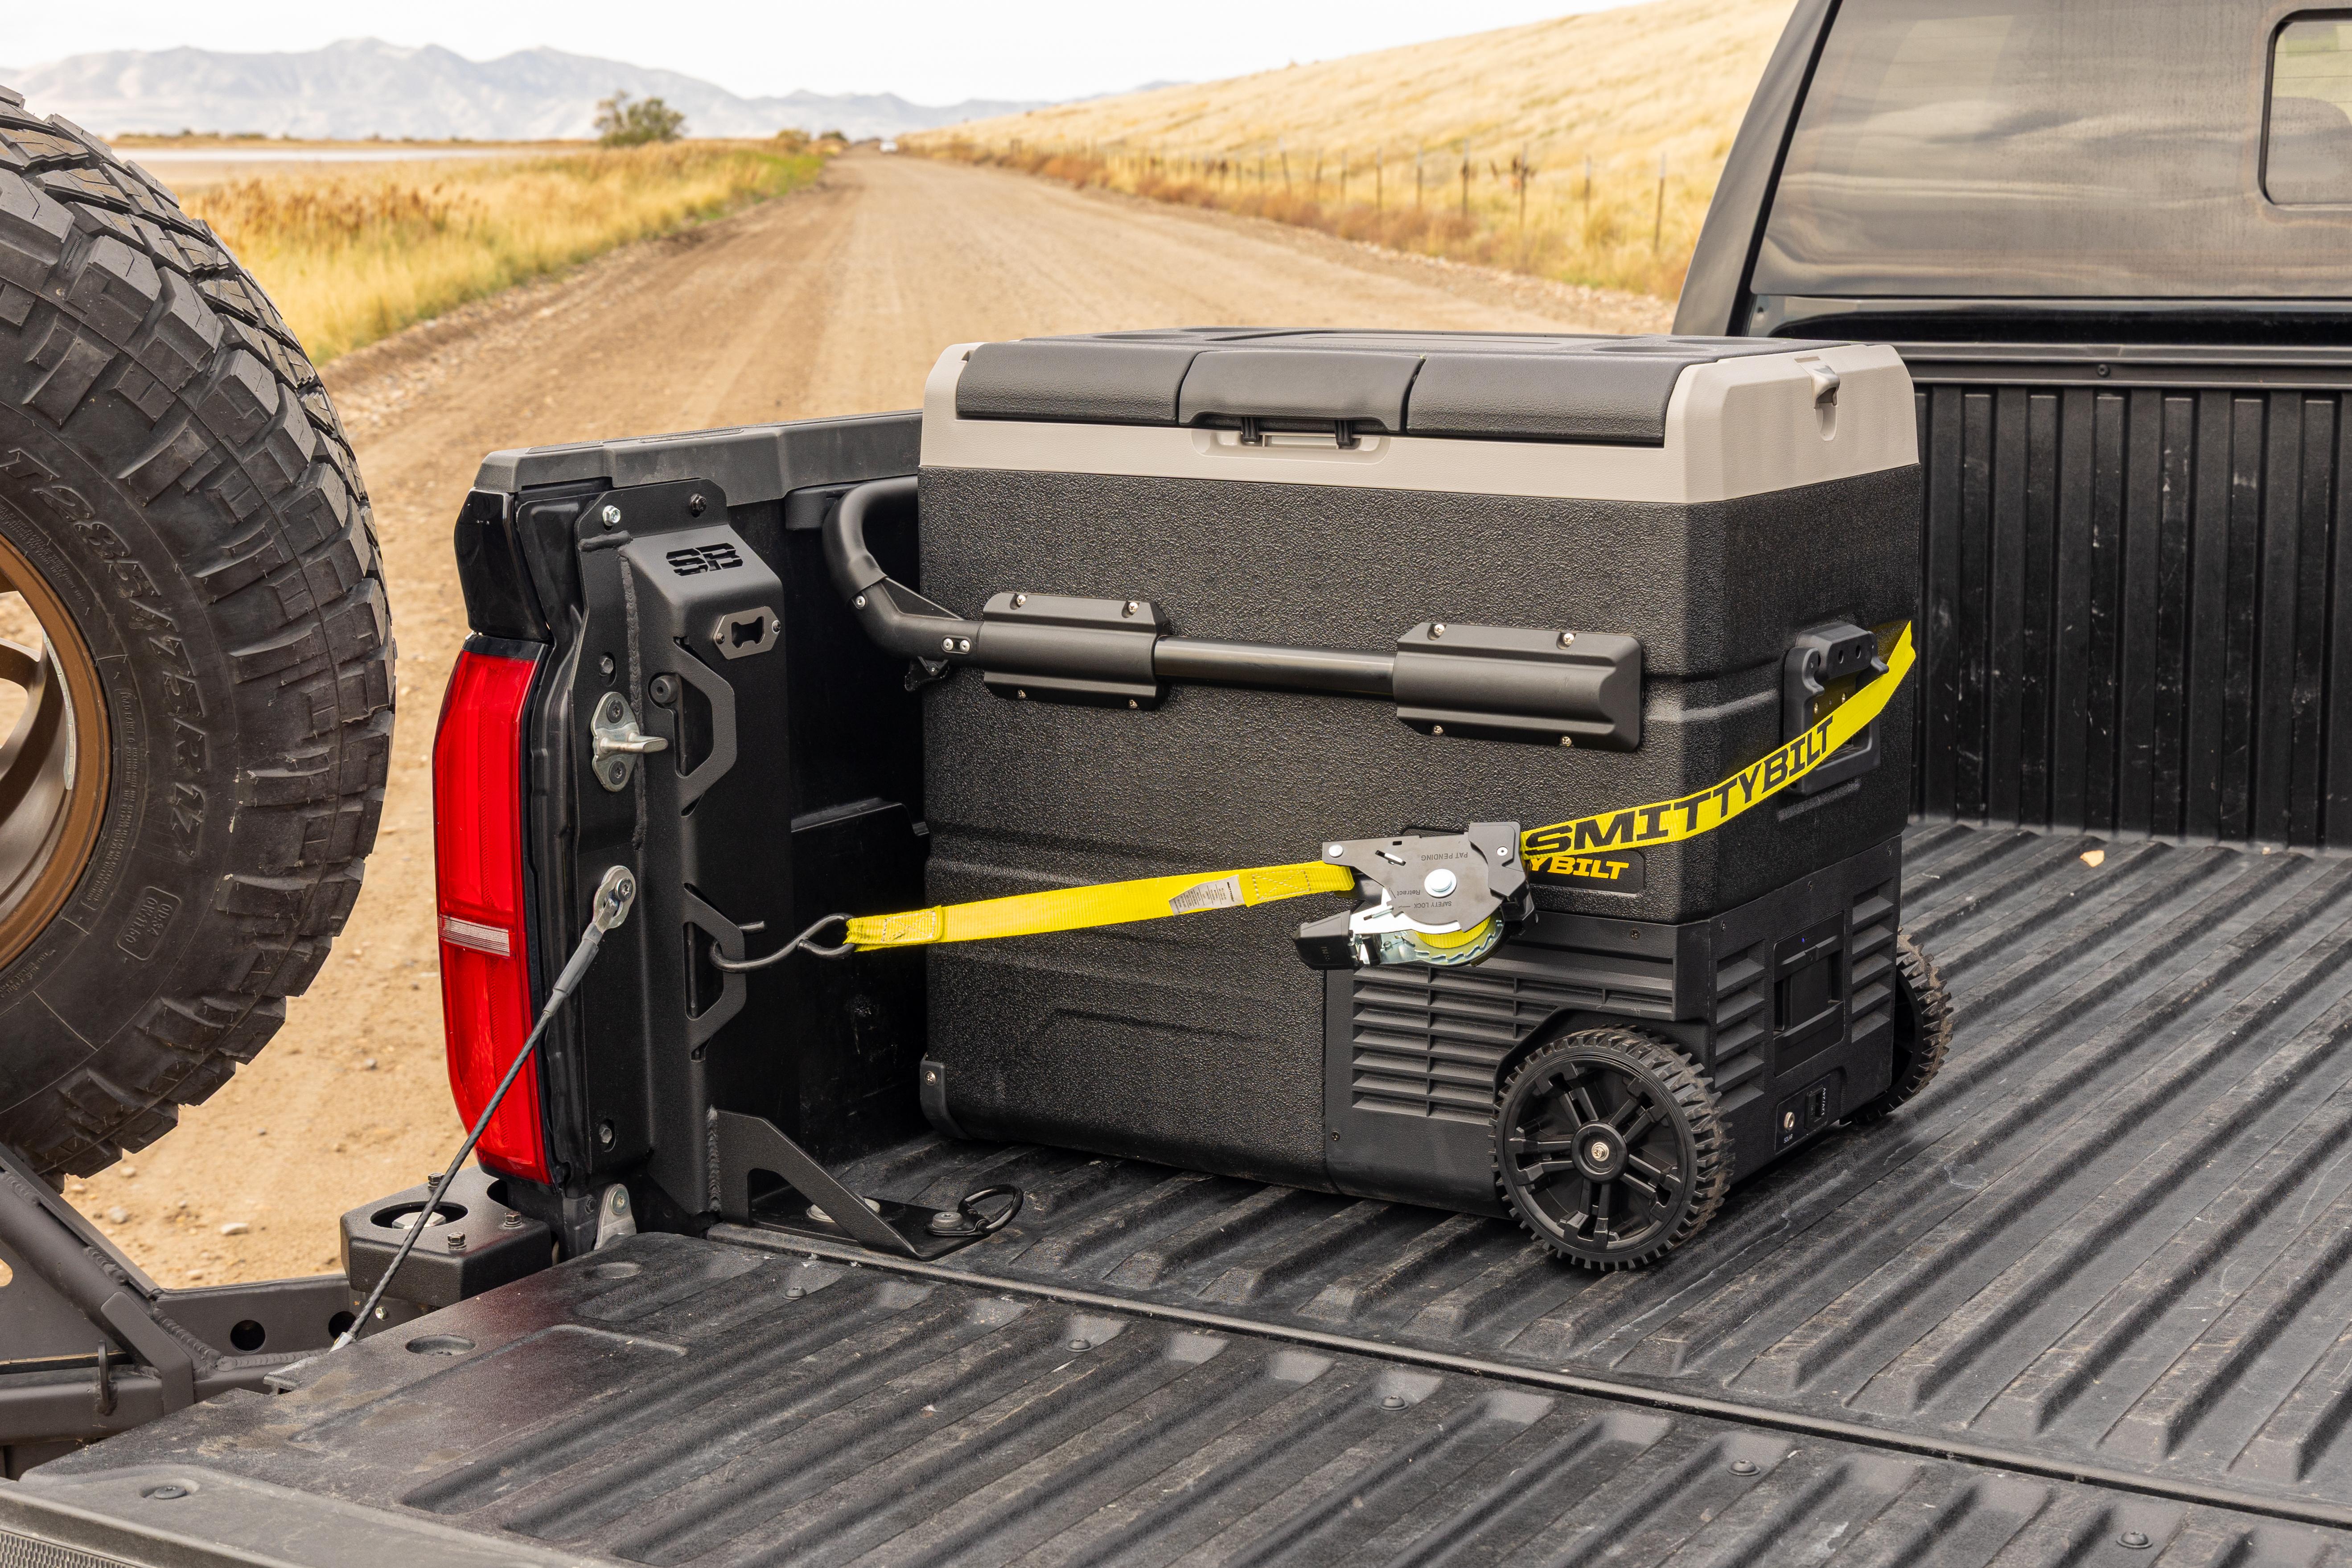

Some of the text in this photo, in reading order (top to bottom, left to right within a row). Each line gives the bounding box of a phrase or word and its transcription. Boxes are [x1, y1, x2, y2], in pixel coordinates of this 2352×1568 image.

[1524, 716, 1833, 856] SMITTYBILT
[1421, 853, 1452, 861] PENDING
[1784, 1134, 1793, 1143] SOLAR
